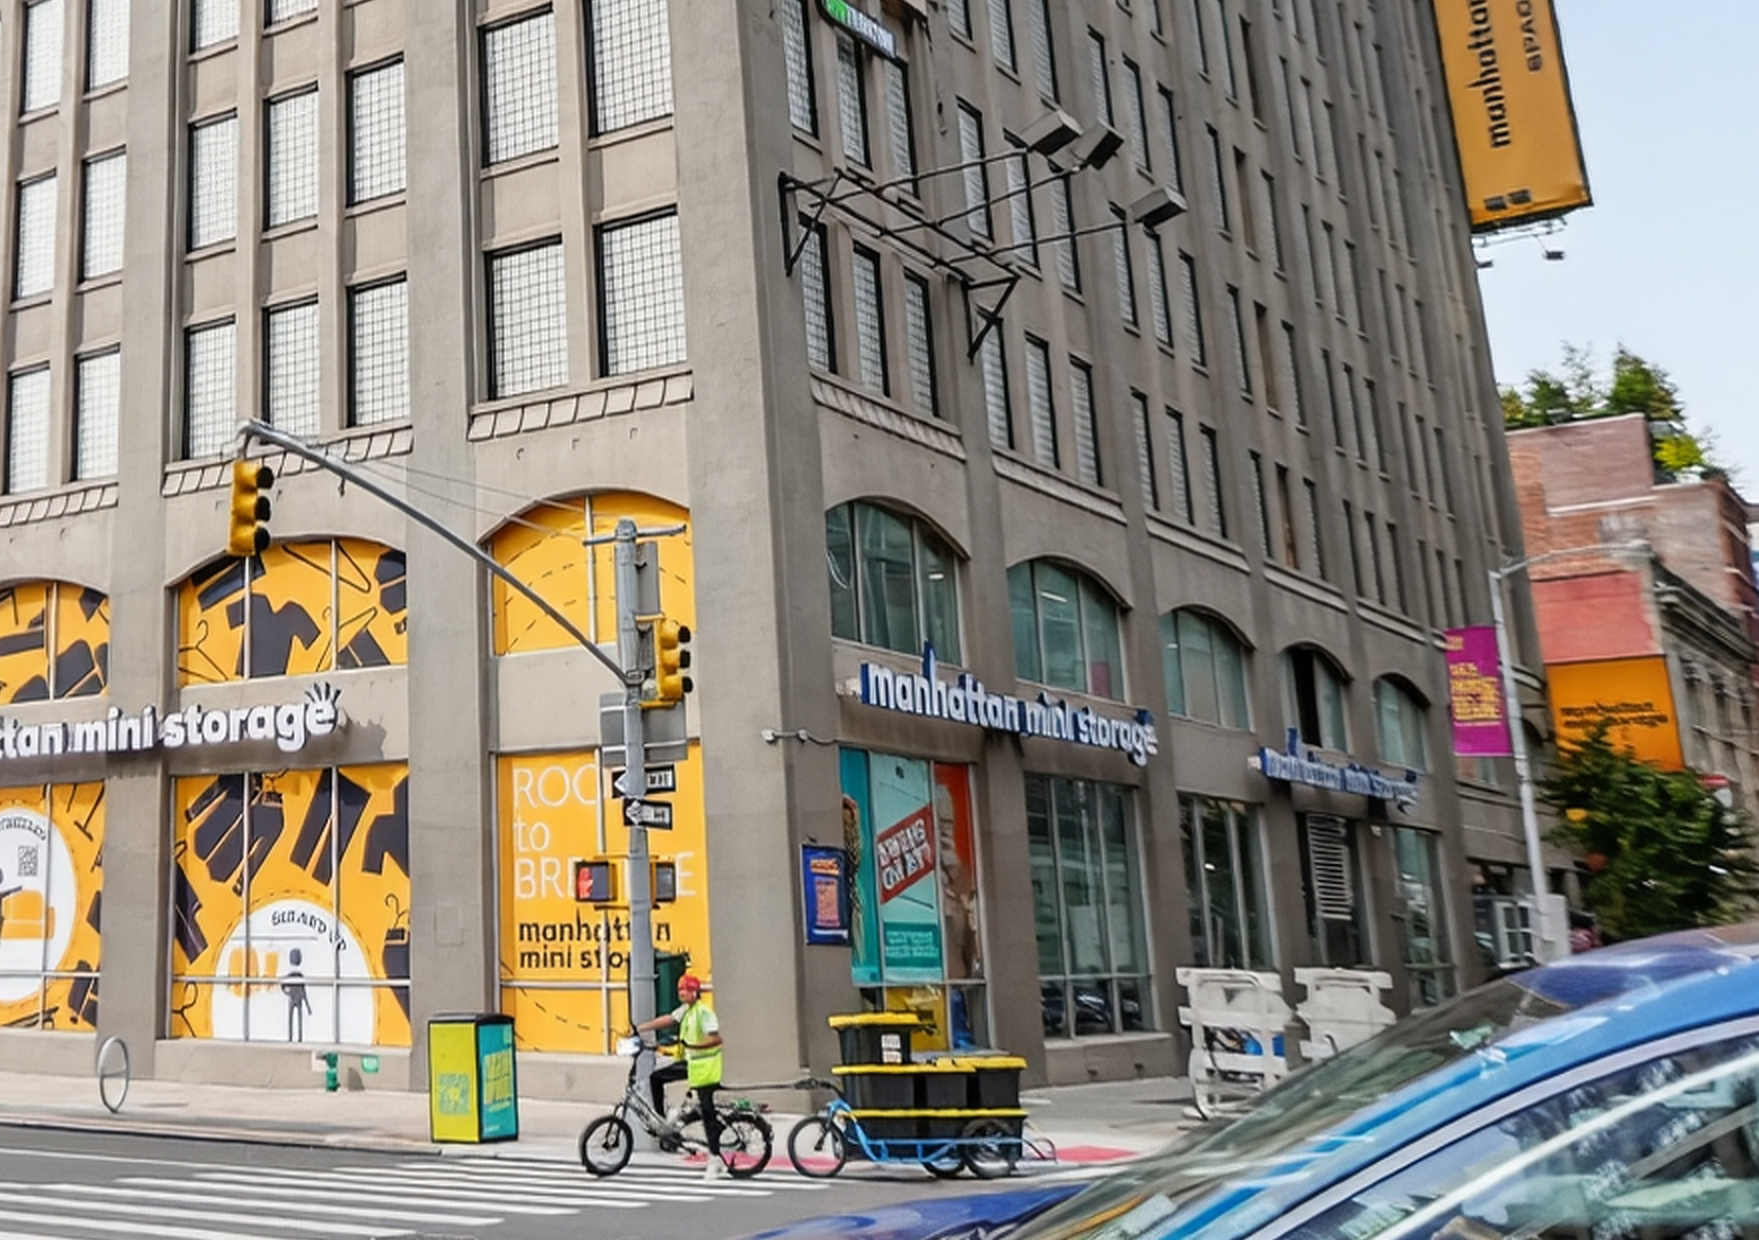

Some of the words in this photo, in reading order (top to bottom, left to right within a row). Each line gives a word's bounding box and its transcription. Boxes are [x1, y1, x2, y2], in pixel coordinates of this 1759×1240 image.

[73, 705, 156, 753] mini
[162, 692, 337, 752] storage
[862, 640, 1022, 733] manhattan
[1024, 691, 1073, 741] mini
[1077, 709, 1158, 767] storage
[513, 763, 606, 808] ROO
[513, 814, 551, 852] to
[518, 907, 672, 942] manhattn
[519, 944, 572, 968] mini
